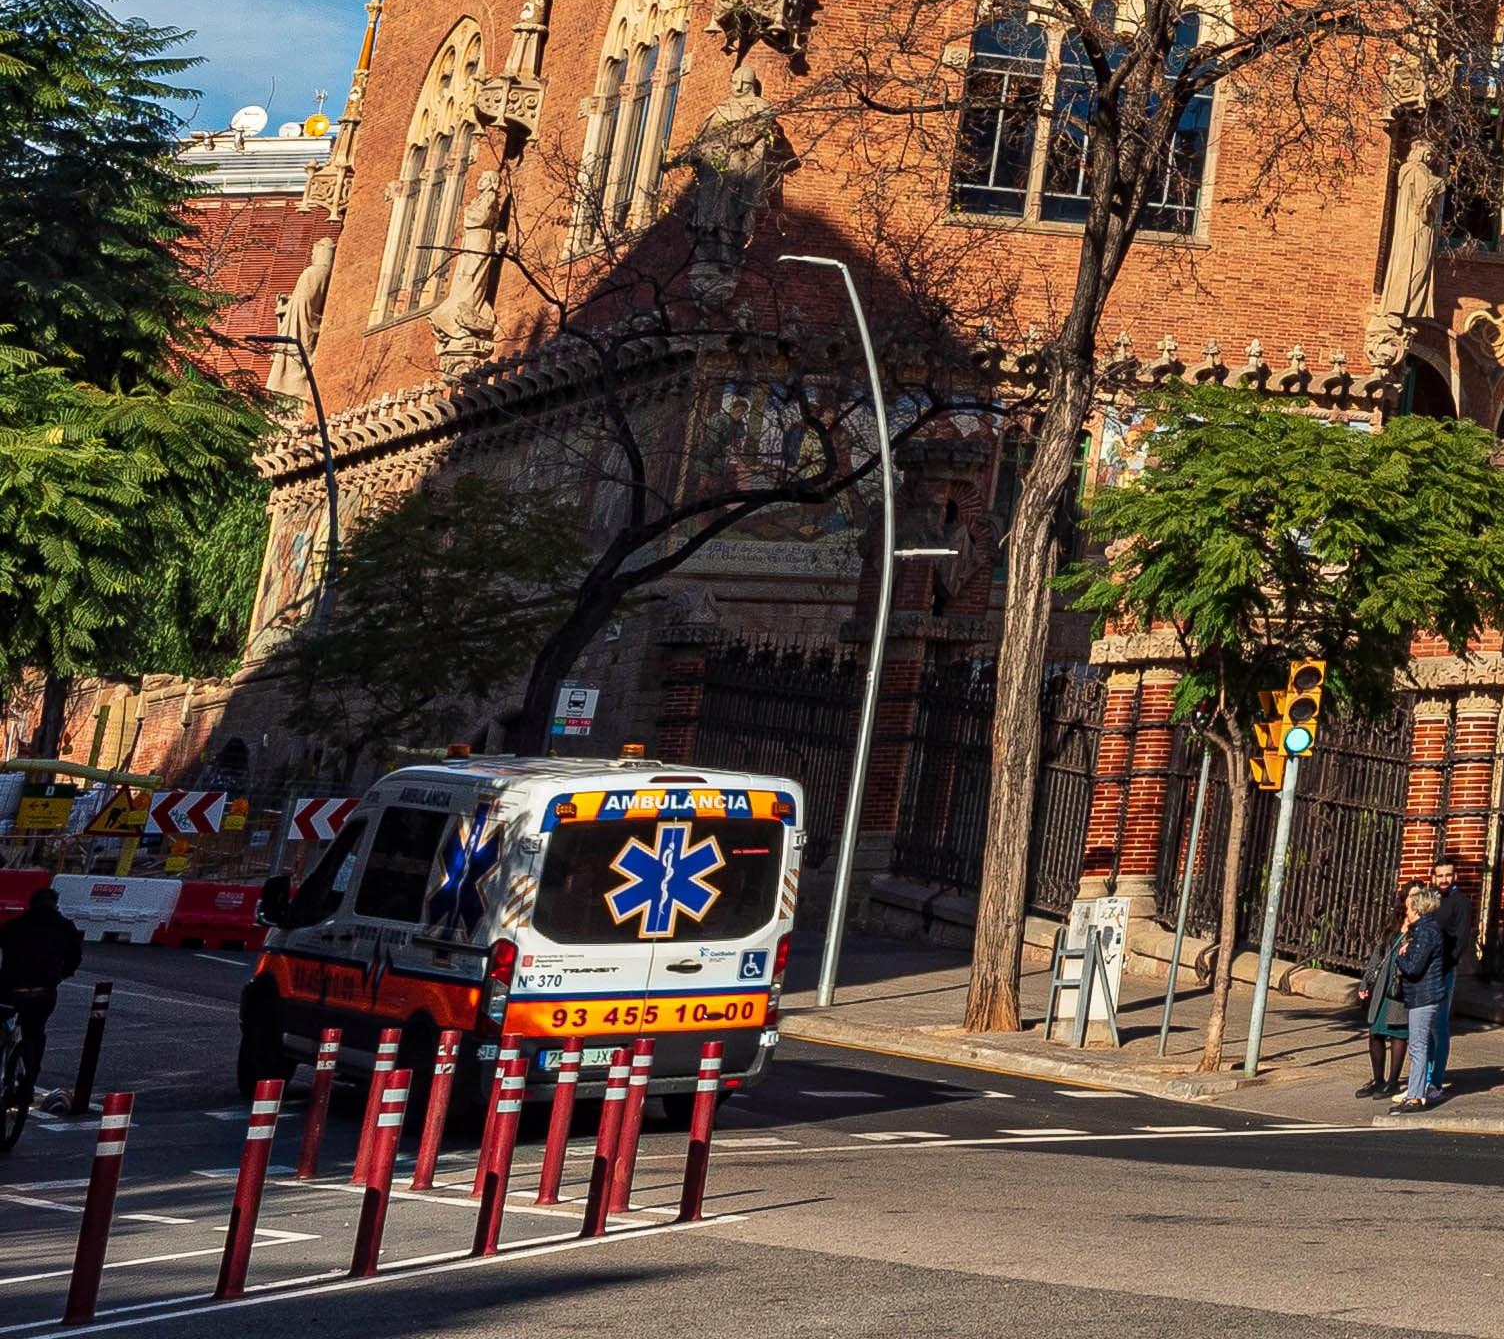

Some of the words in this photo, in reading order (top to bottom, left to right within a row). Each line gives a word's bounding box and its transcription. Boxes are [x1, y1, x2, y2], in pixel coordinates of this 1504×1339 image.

[605, 790, 748, 810] AMBULÀNCIA
[536, 974, 563, 988] 370
[552, 1008, 588, 1028] 93
[603, 1005, 659, 1026] 455
[675, 1003, 708, 1023] 10
[724, 1001, 755, 1021] 00
[592, 1050, 613, 1064] JX
